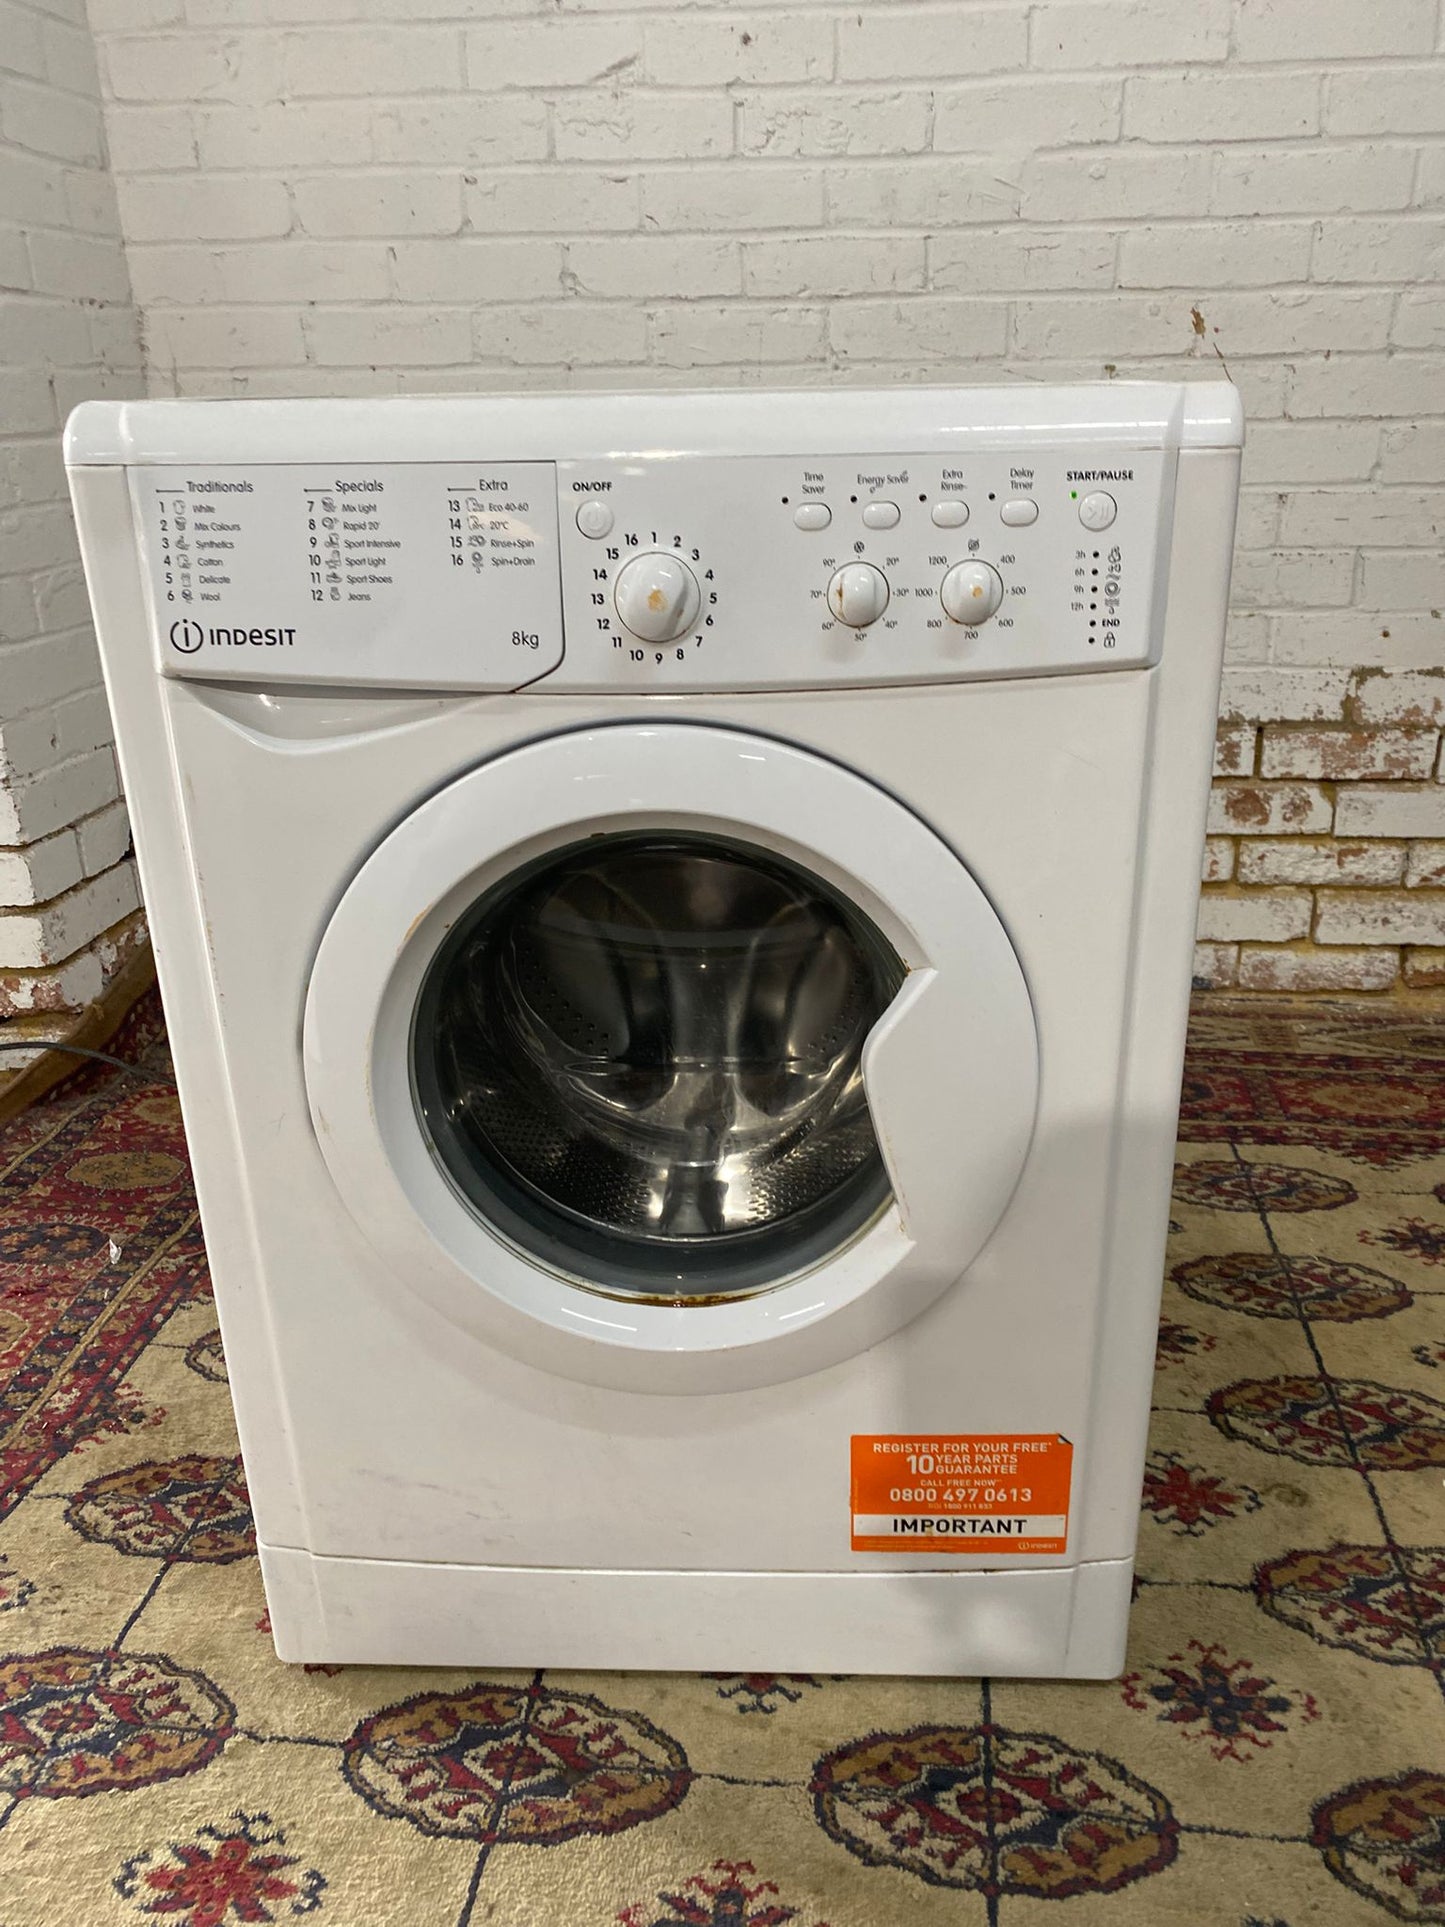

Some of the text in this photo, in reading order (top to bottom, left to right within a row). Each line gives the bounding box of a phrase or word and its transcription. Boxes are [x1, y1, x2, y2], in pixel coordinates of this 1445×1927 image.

[803, 472, 824, 482] Time
[942, 469, 963, 480] Extra
[1010, 468, 1034, 480] Delay
[1066, 470, 1134, 481] START/PAUSE
[186, 480, 254, 493] Traditionals
[479, 479, 508, 492] Extra
[857, 474, 885, 487] Energy
[1010, 480, 1033, 490] Timer
[335, 480, 384, 494] Specials
[572, 482, 612, 492] ON/OFF
[802, 484, 825, 495] Saver
[158, 500, 216, 514] 1 White
[307, 500, 377, 514] 7 Mix Light
[448, 500, 529, 512] 13 Eco 40-60
[160, 519, 241, 532] 2 Mix Colours
[308, 519, 316, 530] 8
[343, 520, 367, 531] Rapid
[448, 518, 462, 530] 14
[162, 537, 235, 550] 3 Synthetics
[309, 537, 401, 549] 9 Sport Intensive
[450, 536, 462, 548] 15
[625, 534, 638, 546] 16
[651, 532, 657, 544] 1
[674, 536, 682, 548] 2
[450, 554, 464, 566] 16
[606, 548, 620, 560] 15
[692, 548, 700, 561] 3
[1000, 554, 1016, 564] 400
[164, 555, 224, 567] 4 Cotton
[309, 555, 386, 568] 10 Sport Light
[928, 556, 947, 565] 1200
[165, 572, 231, 584] 5 Delicate
[310, 572, 393, 585] 11 Sport Shoes
[593, 569, 608, 580] 14
[705, 569, 714, 580] 4
[167, 590, 221, 602] 6 Wool
[310, 590, 372, 602] 12 Jeans
[914, 588, 933, 596] 1000
[1010, 586, 1026, 595] 500
[591, 594, 604, 605] 13
[710, 592, 718, 604] 5
[597, 618, 610, 630] 12
[706, 614, 714, 626] 6
[926, 620, 942, 628] 800
[998, 618, 1014, 628] 600
[1102, 618, 1120, 627] END
[512, 630, 540, 650] 8kg
[964, 630, 978, 640] 700
[612, 636, 622, 648] 11
[695, 636, 703, 648] 7
[630, 650, 644, 662] 10
[655, 652, 663, 664] 9
[676, 649, 684, 660] 8
[873, 1442, 939, 1453] REGISTER
[943, 1442, 970, 1452] FOR
[972, 1442, 1010, 1452] YOUR
[906, 1454, 934, 1475] 10
[936, 1454, 1018, 1464] YEAR PARTS
[936, 1464, 1018, 1475] GUARANTEE
[920, 1479, 944, 1487] CALL
[947, 1479, 971, 1487] FREE
[890, 1488, 1032, 1502] 0800 497 0613
[893, 1518, 1028, 1534] IMPORTANT
